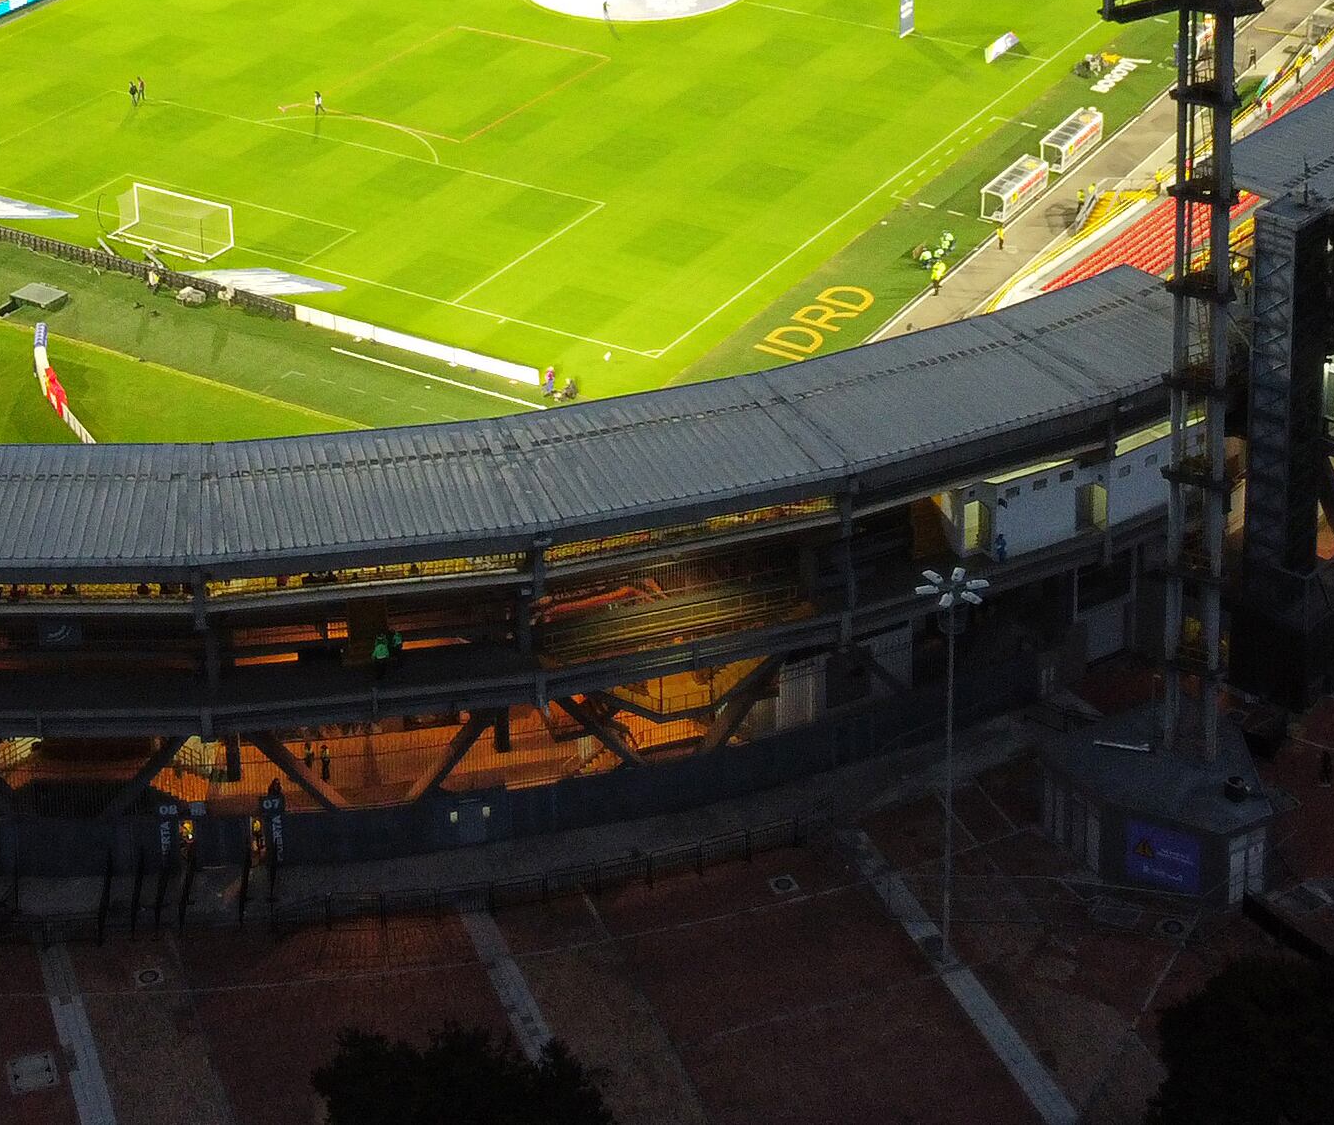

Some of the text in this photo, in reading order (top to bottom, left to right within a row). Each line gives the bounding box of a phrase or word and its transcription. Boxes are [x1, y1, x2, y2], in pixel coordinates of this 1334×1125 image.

[753, 285, 875, 362] IDRD
[263, 798, 281, 809] 07
[159, 804, 178, 815] 08
